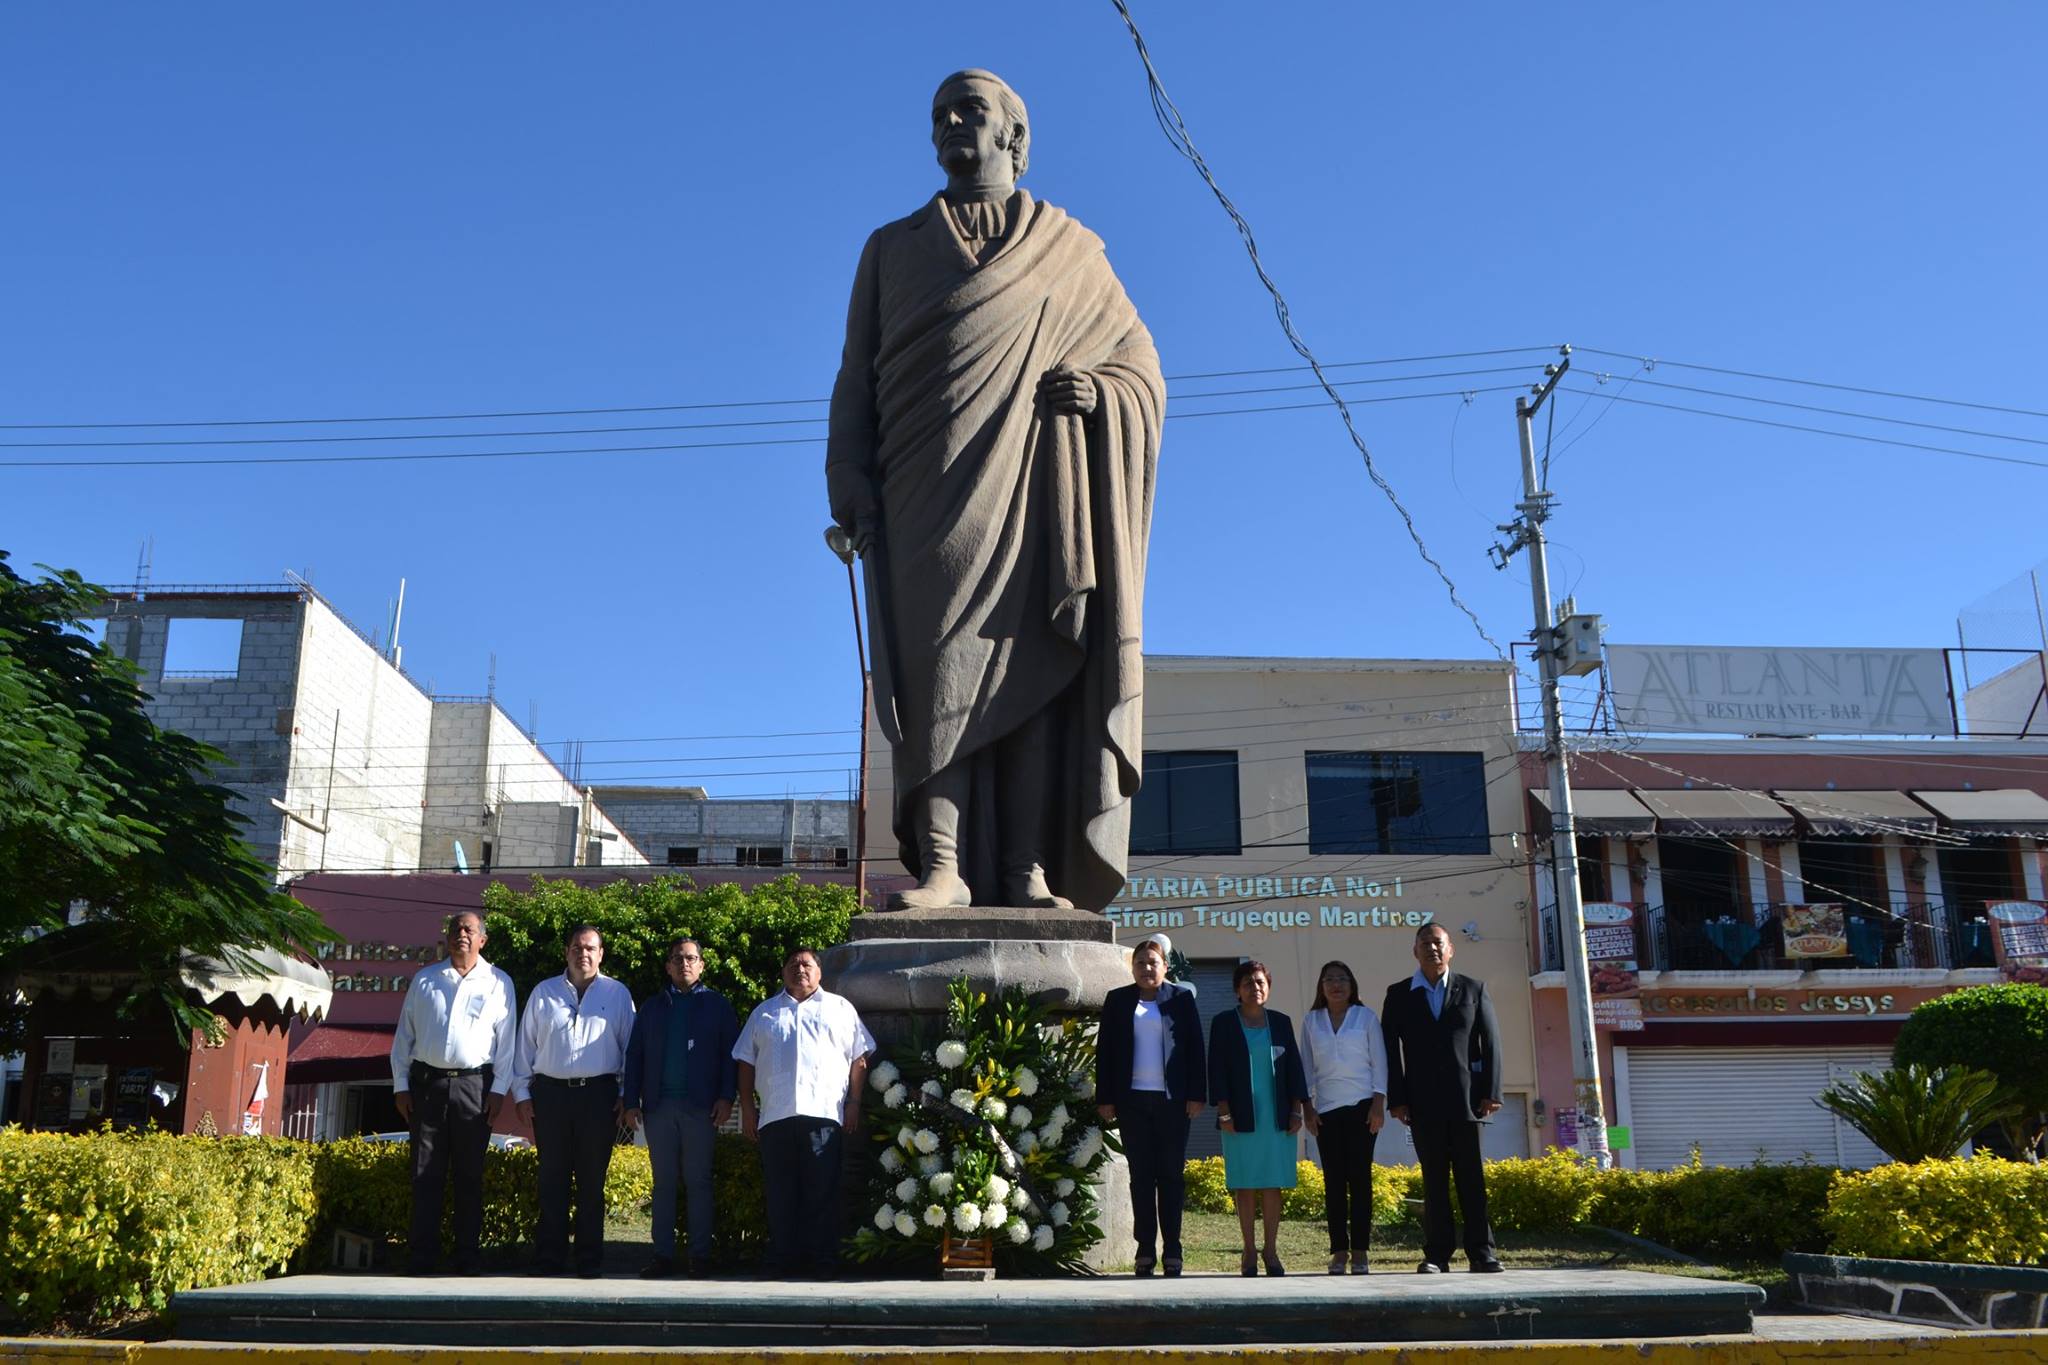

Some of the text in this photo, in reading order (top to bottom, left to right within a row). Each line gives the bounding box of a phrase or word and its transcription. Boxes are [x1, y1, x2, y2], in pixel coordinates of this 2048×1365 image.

[1629, 650, 1943, 727] ATLANTA
[1706, 703, 1818, 719] RESTAURANTE
[1830, 703, 1863, 720] BAR
[1115, 876, 1209, 898] TARIA
[1217, 876, 1338, 898] PUBLICA
[1193, 906, 1312, 933] Trujeque
[1800, 991, 1895, 1016] Jessys
